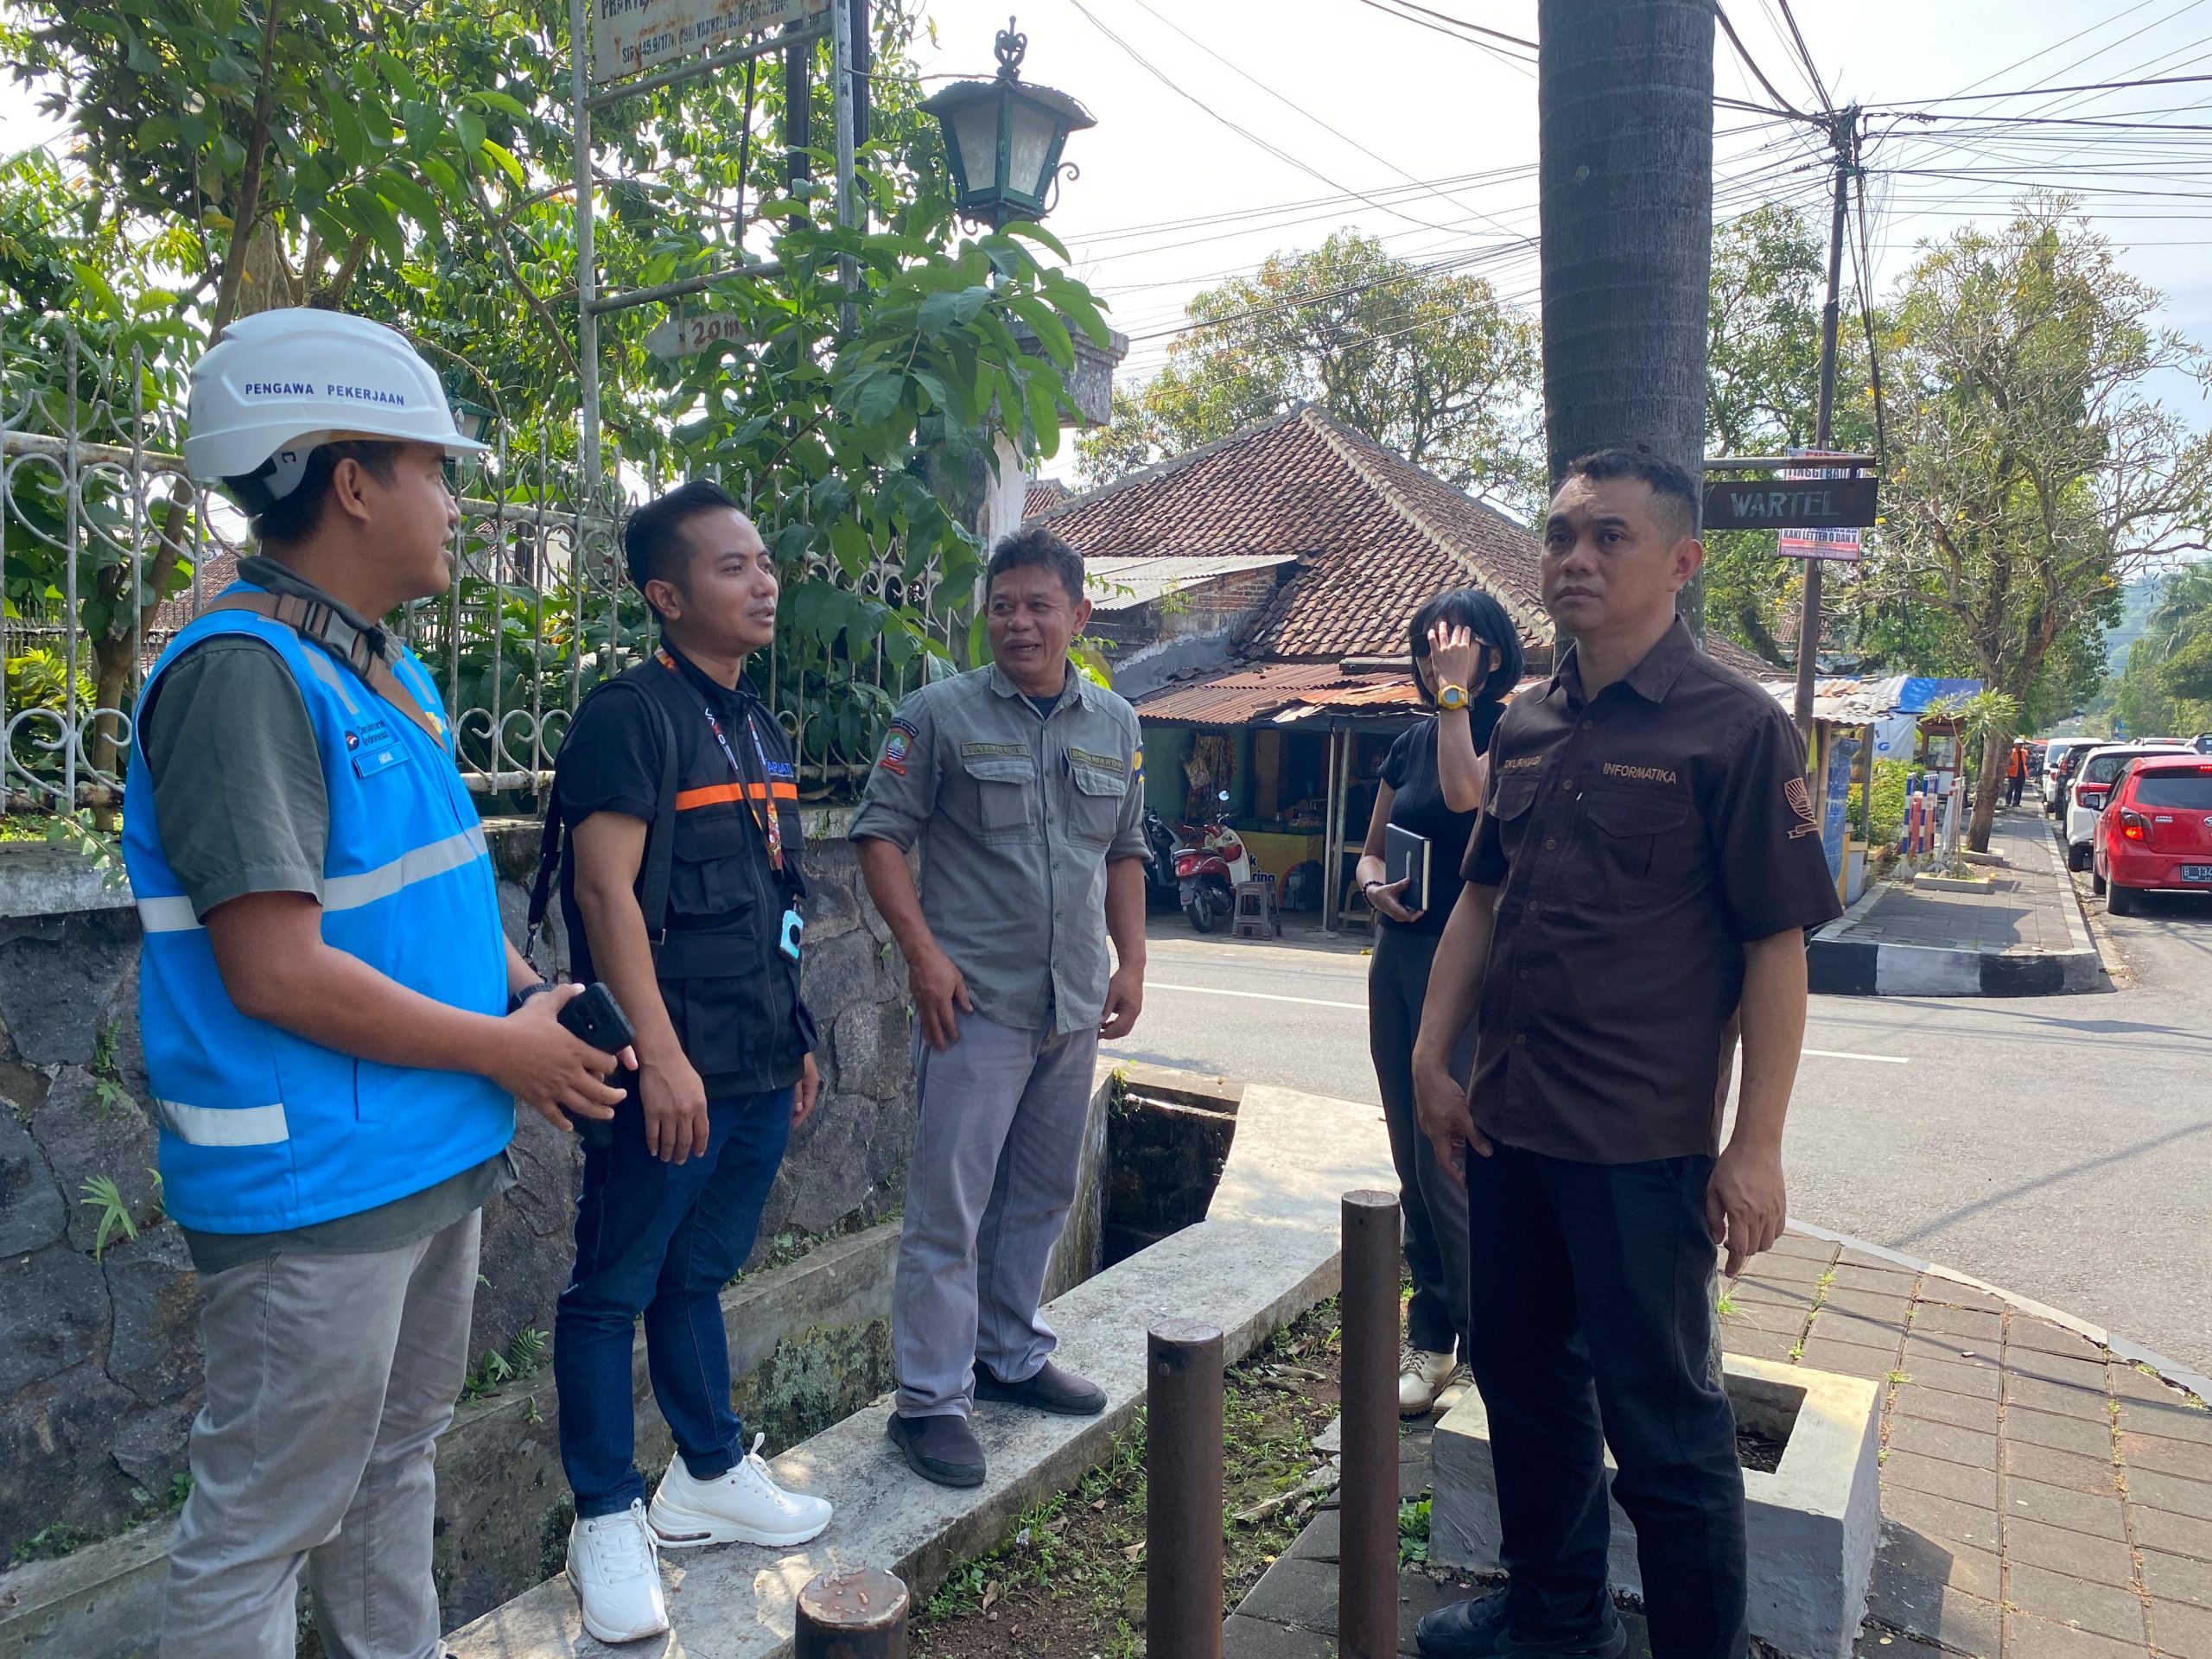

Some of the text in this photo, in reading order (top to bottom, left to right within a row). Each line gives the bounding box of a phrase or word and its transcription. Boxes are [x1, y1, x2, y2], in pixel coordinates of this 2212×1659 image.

[245, 382, 405, 406] PENGAWA PEKERJAAN
[1731, 490, 1841, 518] WARTEL
[1783, 529, 1802, 540] KAKI
[1802, 531, 1827, 542] LETTER
[1835, 533, 1851, 543] DAN
[1852, 534, 1857, 543] X
[1603, 762, 1676, 785] INFORMATIKA
